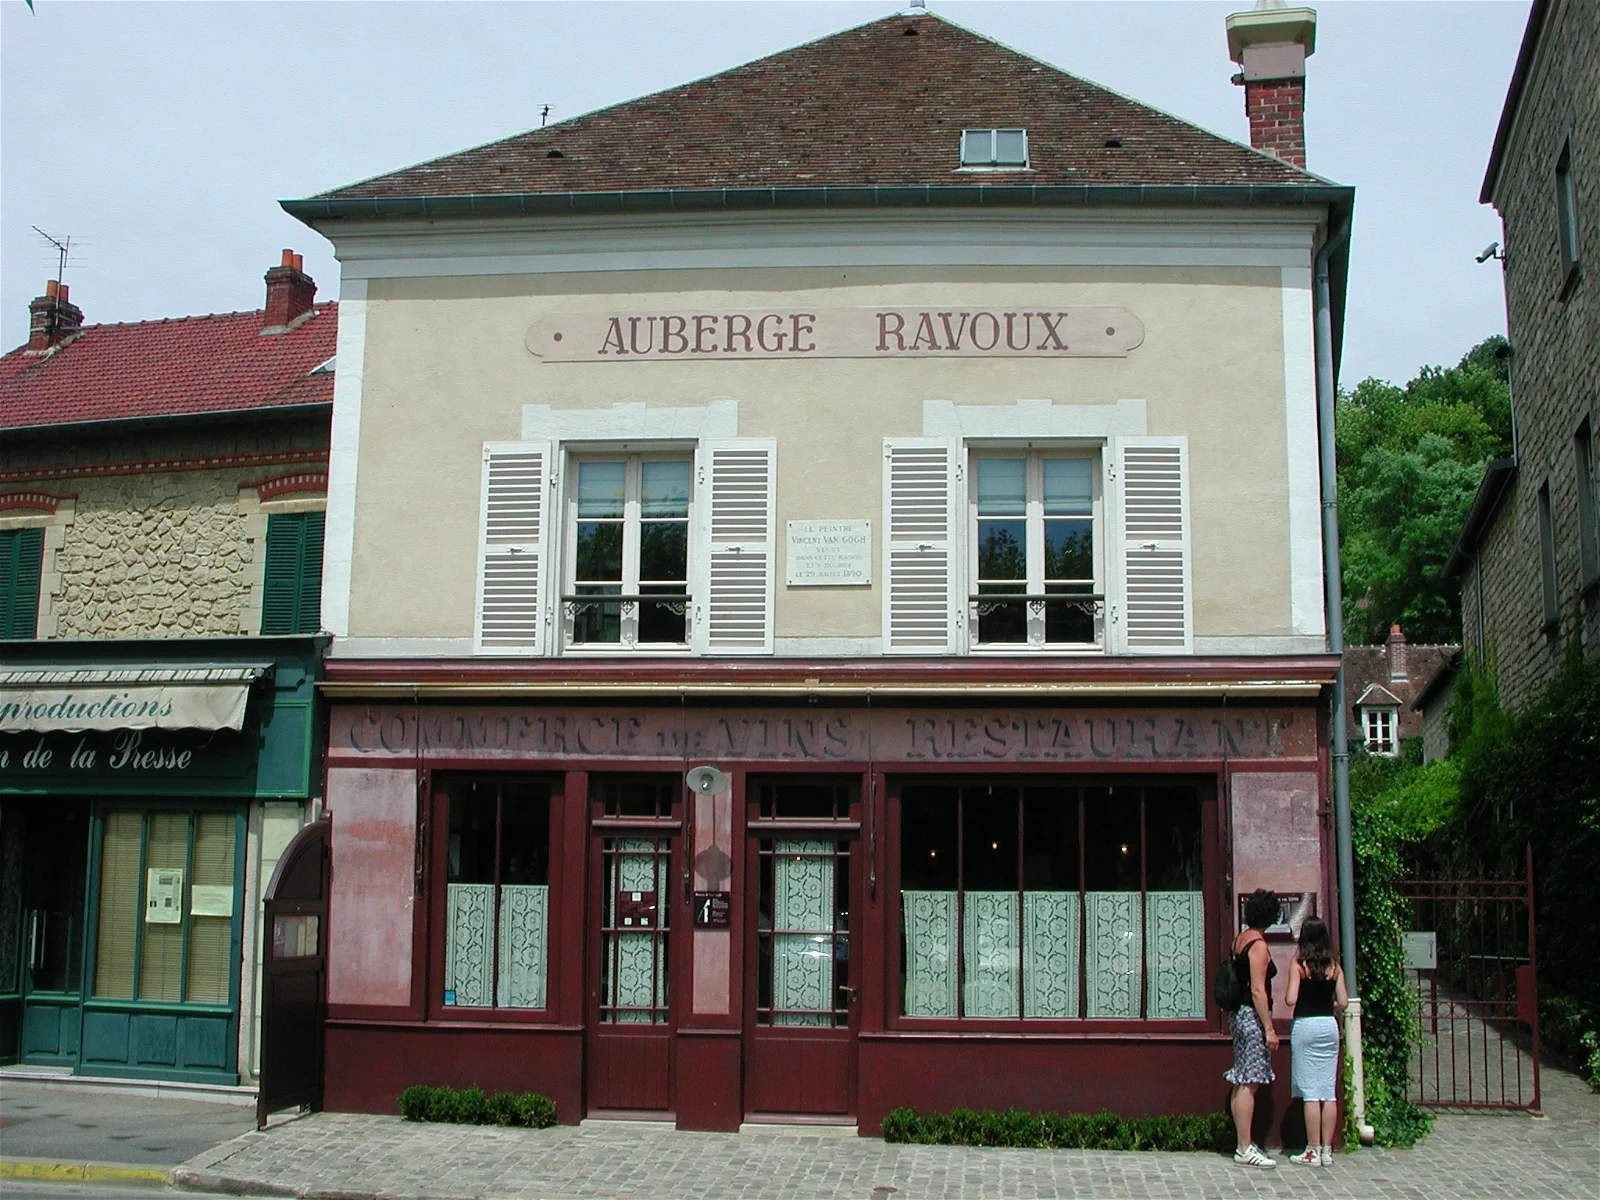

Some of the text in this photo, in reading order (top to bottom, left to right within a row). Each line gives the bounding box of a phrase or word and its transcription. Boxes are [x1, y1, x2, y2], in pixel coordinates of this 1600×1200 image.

[597, 311, 1069, 354] AUBERGE RAVOUX
[791, 535, 866, 545] VINCENT VAN GOGH
[843, 569, 862, 577] 1890
[23, 738, 52, 768] de
[70, 737, 96, 768] la
[109, 730, 192, 769] Presse
[350, 714, 643, 757] COMMERCE
[717, 716, 852, 758] VINS
[906, 710, 1296, 758] RESTAURANT
